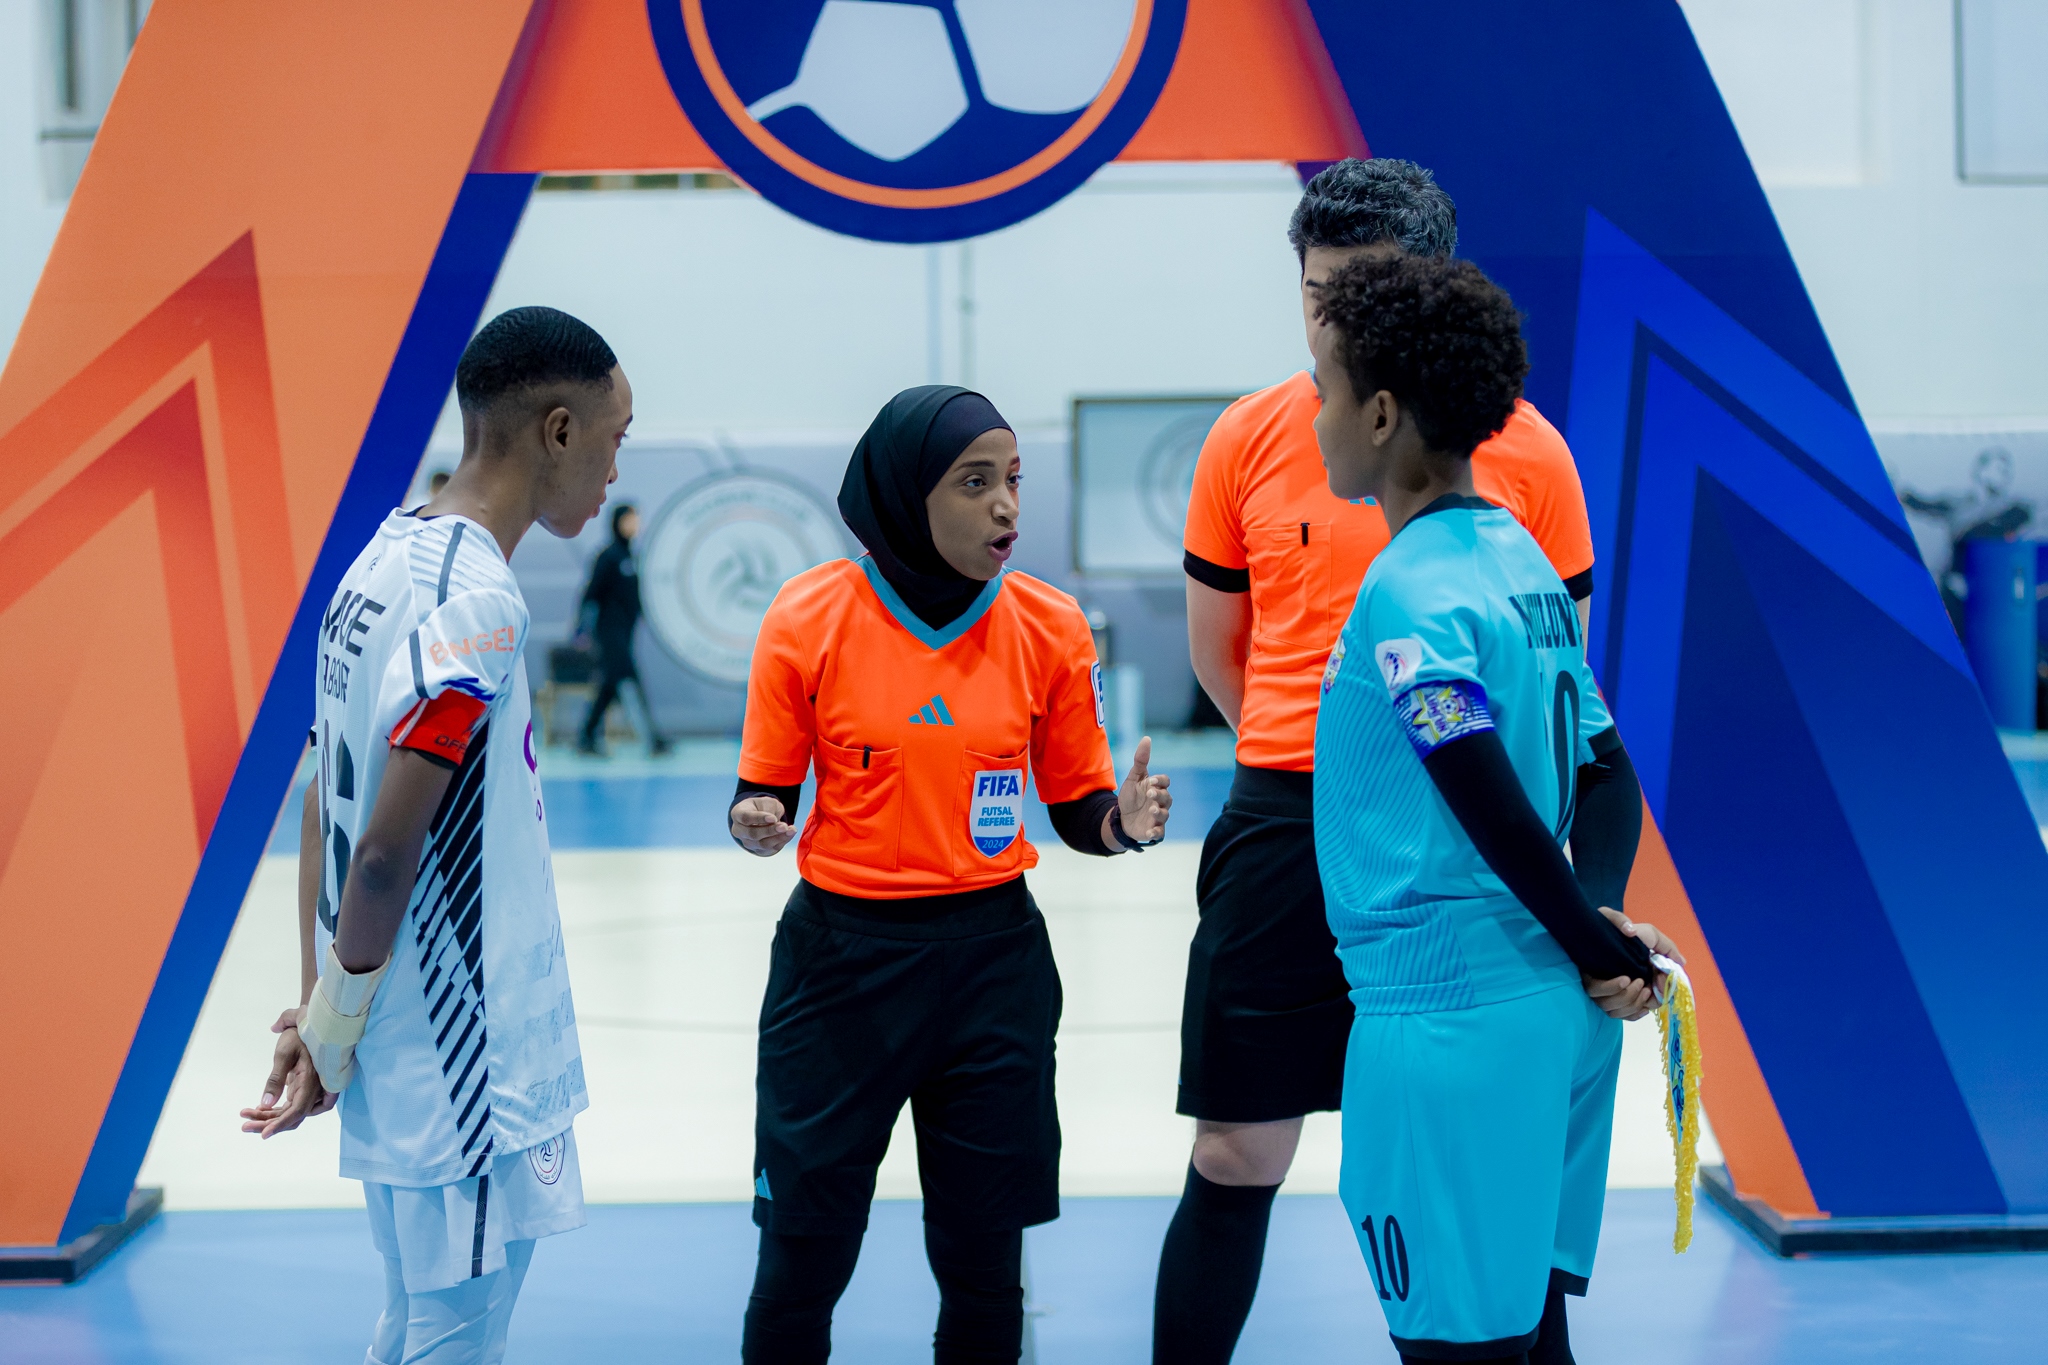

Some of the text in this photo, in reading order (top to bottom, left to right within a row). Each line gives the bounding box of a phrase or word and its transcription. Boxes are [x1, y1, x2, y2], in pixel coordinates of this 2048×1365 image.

[978, 775, 1019, 797] FIFA
[982, 806, 1013, 816] FUTSAL
[978, 816, 1015, 827] REFEREE
[982, 839, 1004, 849] 2024
[1361, 1214, 1410, 1302] 10
